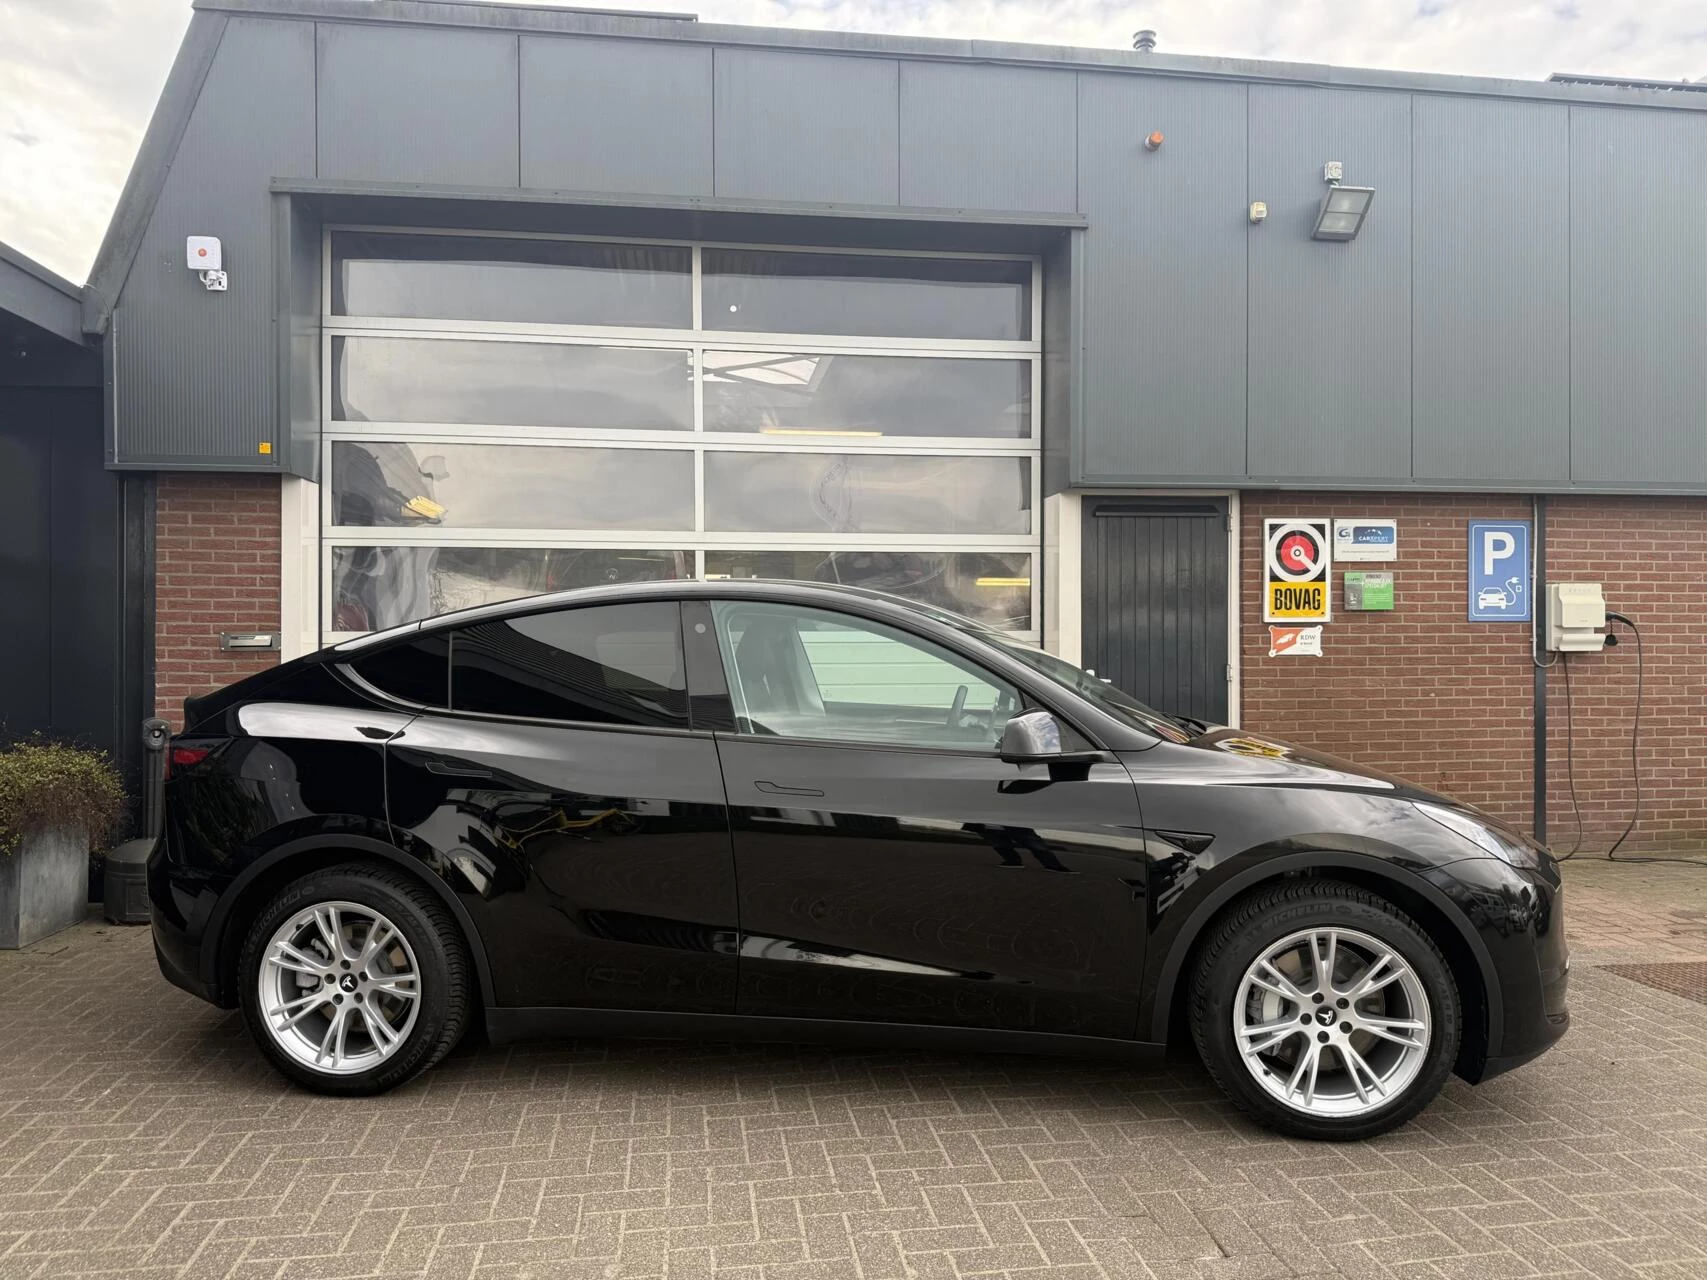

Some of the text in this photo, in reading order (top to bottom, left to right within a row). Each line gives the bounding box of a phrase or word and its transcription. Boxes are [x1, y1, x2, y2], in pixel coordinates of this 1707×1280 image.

[1483, 530, 1516, 576] P
[1274, 587, 1321, 612] BOVAG
[1262, 902, 1332, 927] MICHELIN
